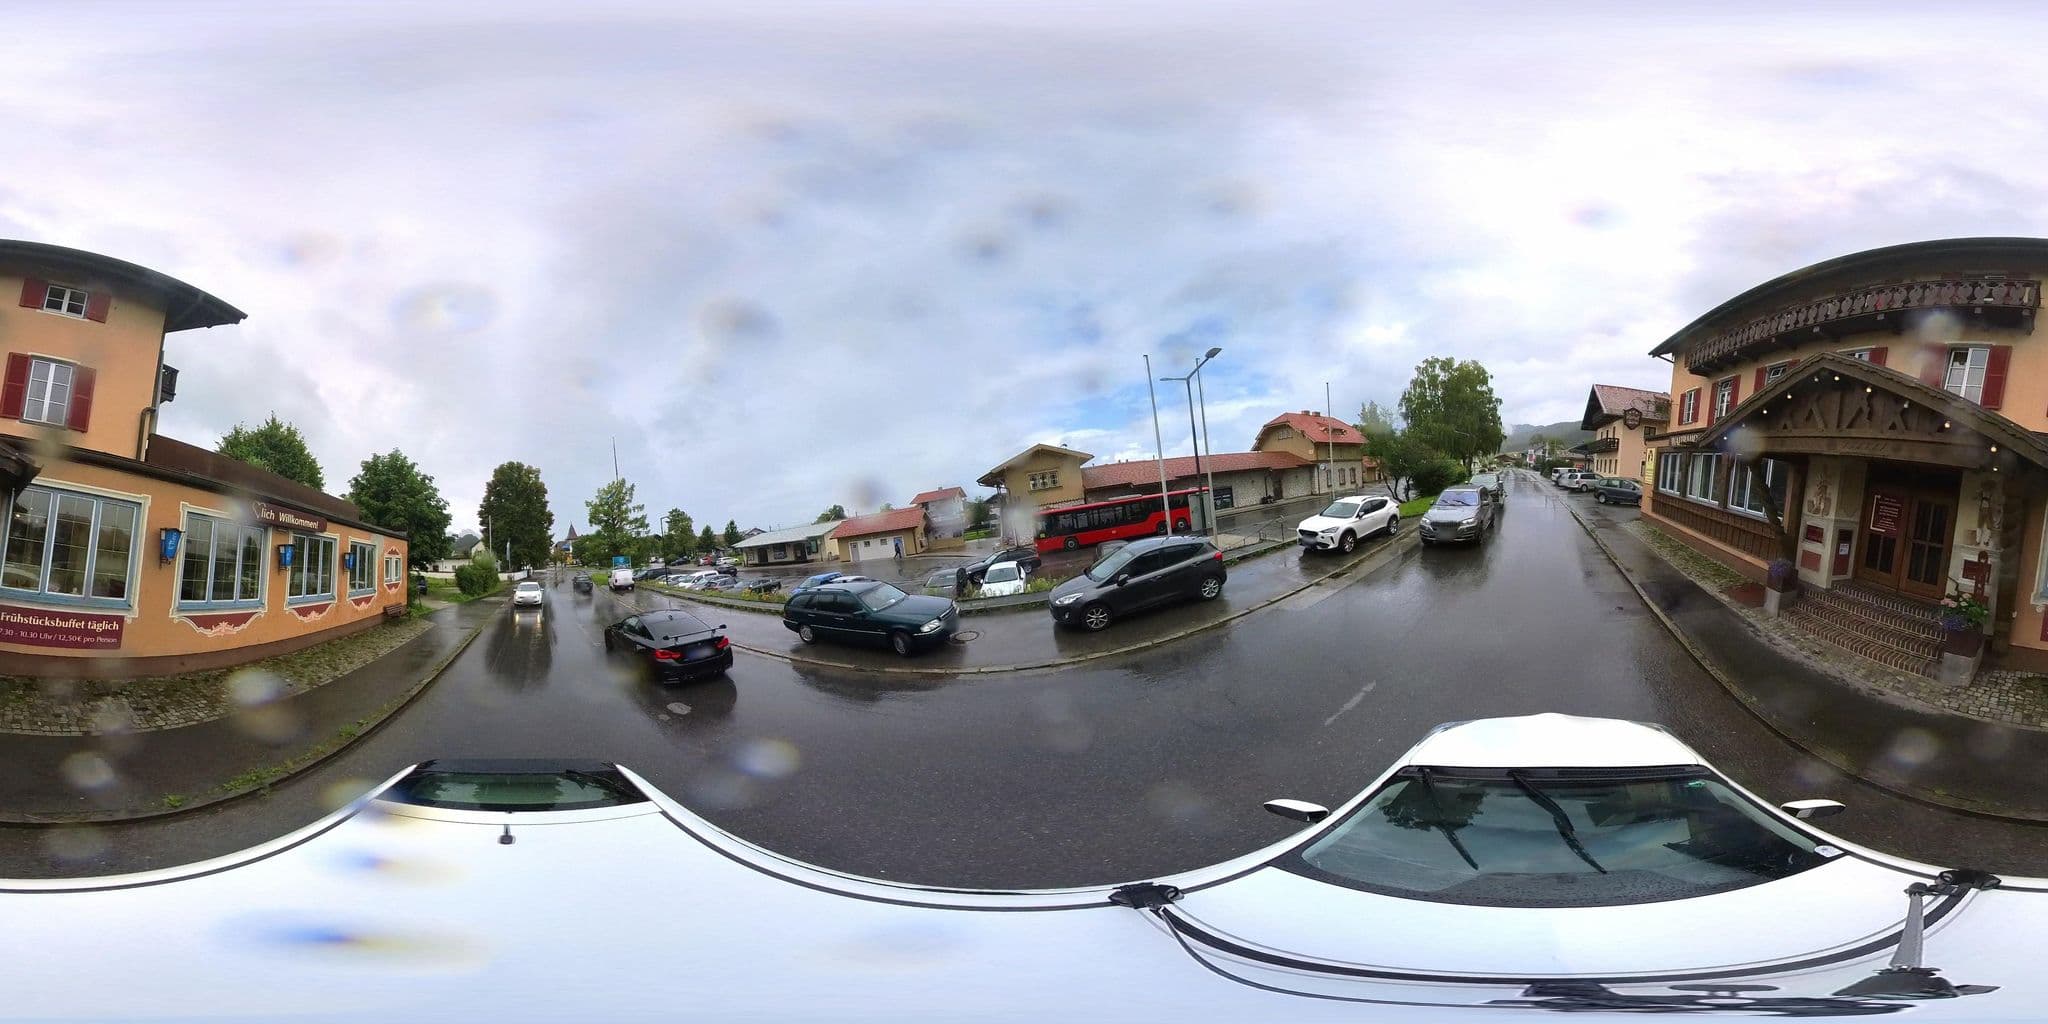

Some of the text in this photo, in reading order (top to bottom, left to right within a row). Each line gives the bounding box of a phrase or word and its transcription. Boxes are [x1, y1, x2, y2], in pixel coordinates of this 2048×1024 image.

[279, 512, 319, 529] Willkommen!
[0, 612, 119, 632] Frühstücksbuffet täglich
[83, 636, 95, 644] pro
